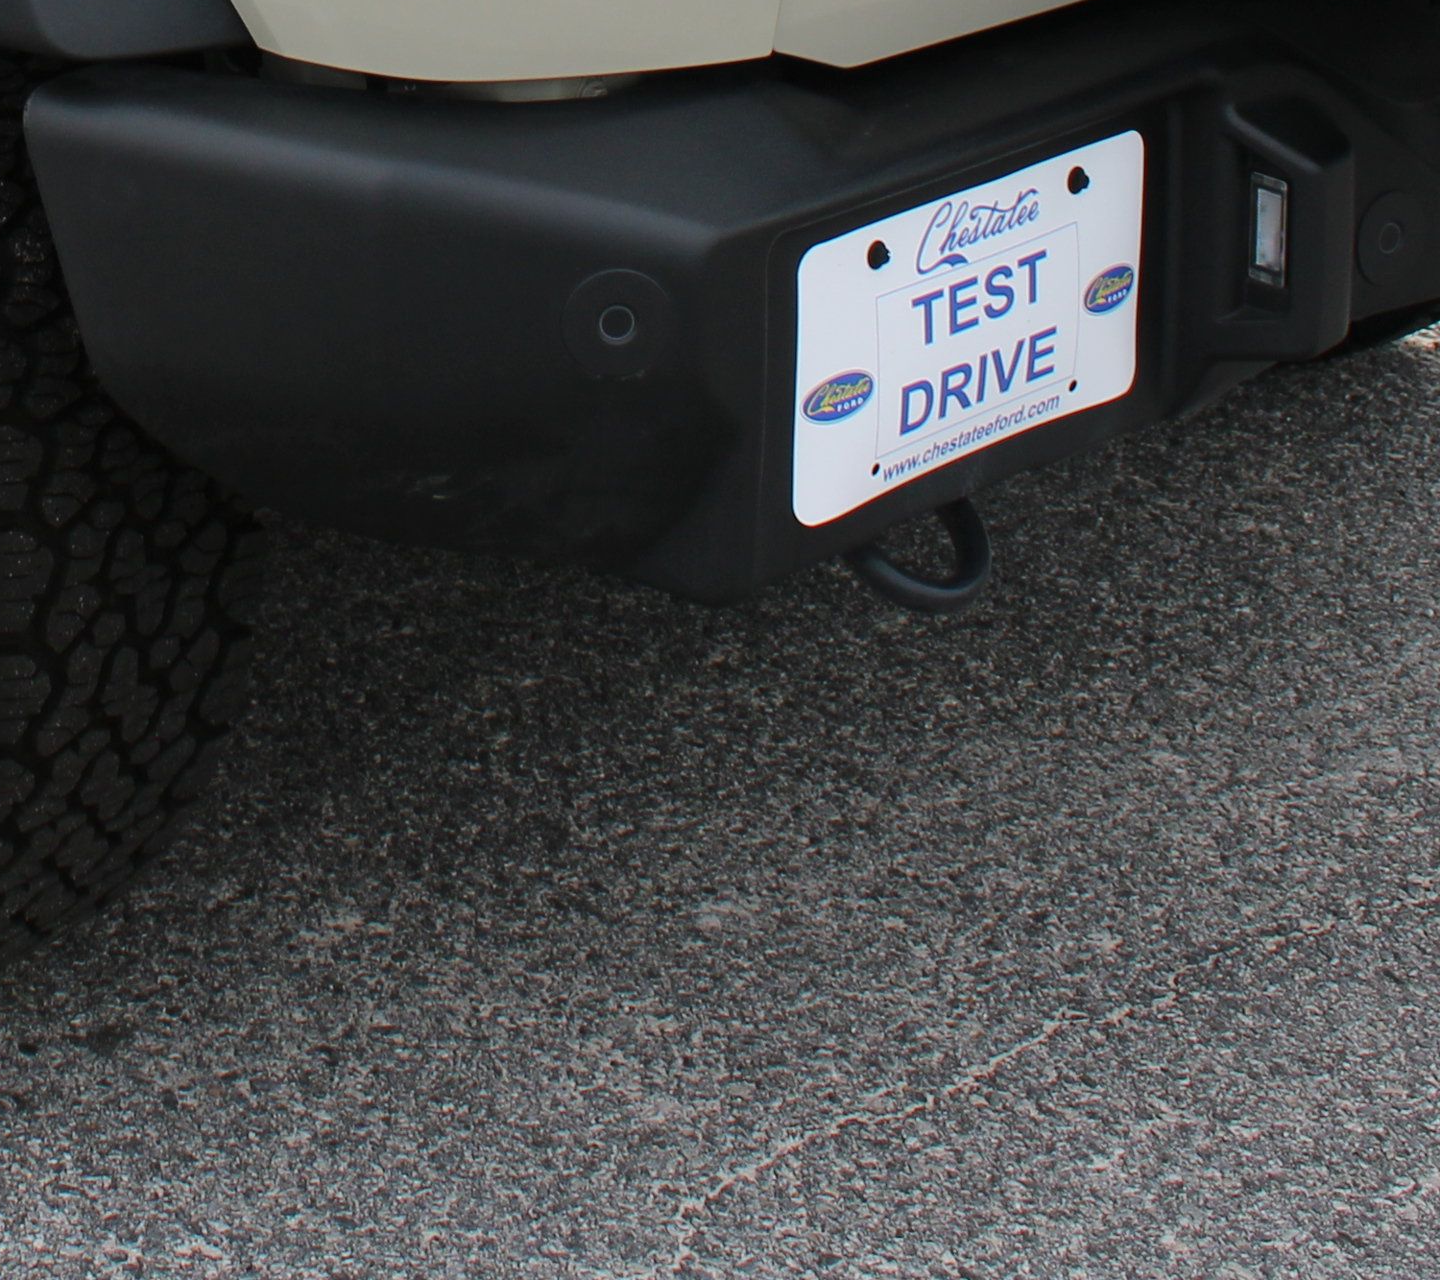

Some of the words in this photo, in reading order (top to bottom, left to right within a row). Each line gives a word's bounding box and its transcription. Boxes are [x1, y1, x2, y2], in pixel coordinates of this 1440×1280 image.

[916, 187, 1039, 276] Chestatee
[910, 249, 1048, 346] TEST
[836, 396, 865, 413] FORD
[898, 325, 1058, 437] DRIVE
[882, 394, 1060, 483] www.chestateeford.com
